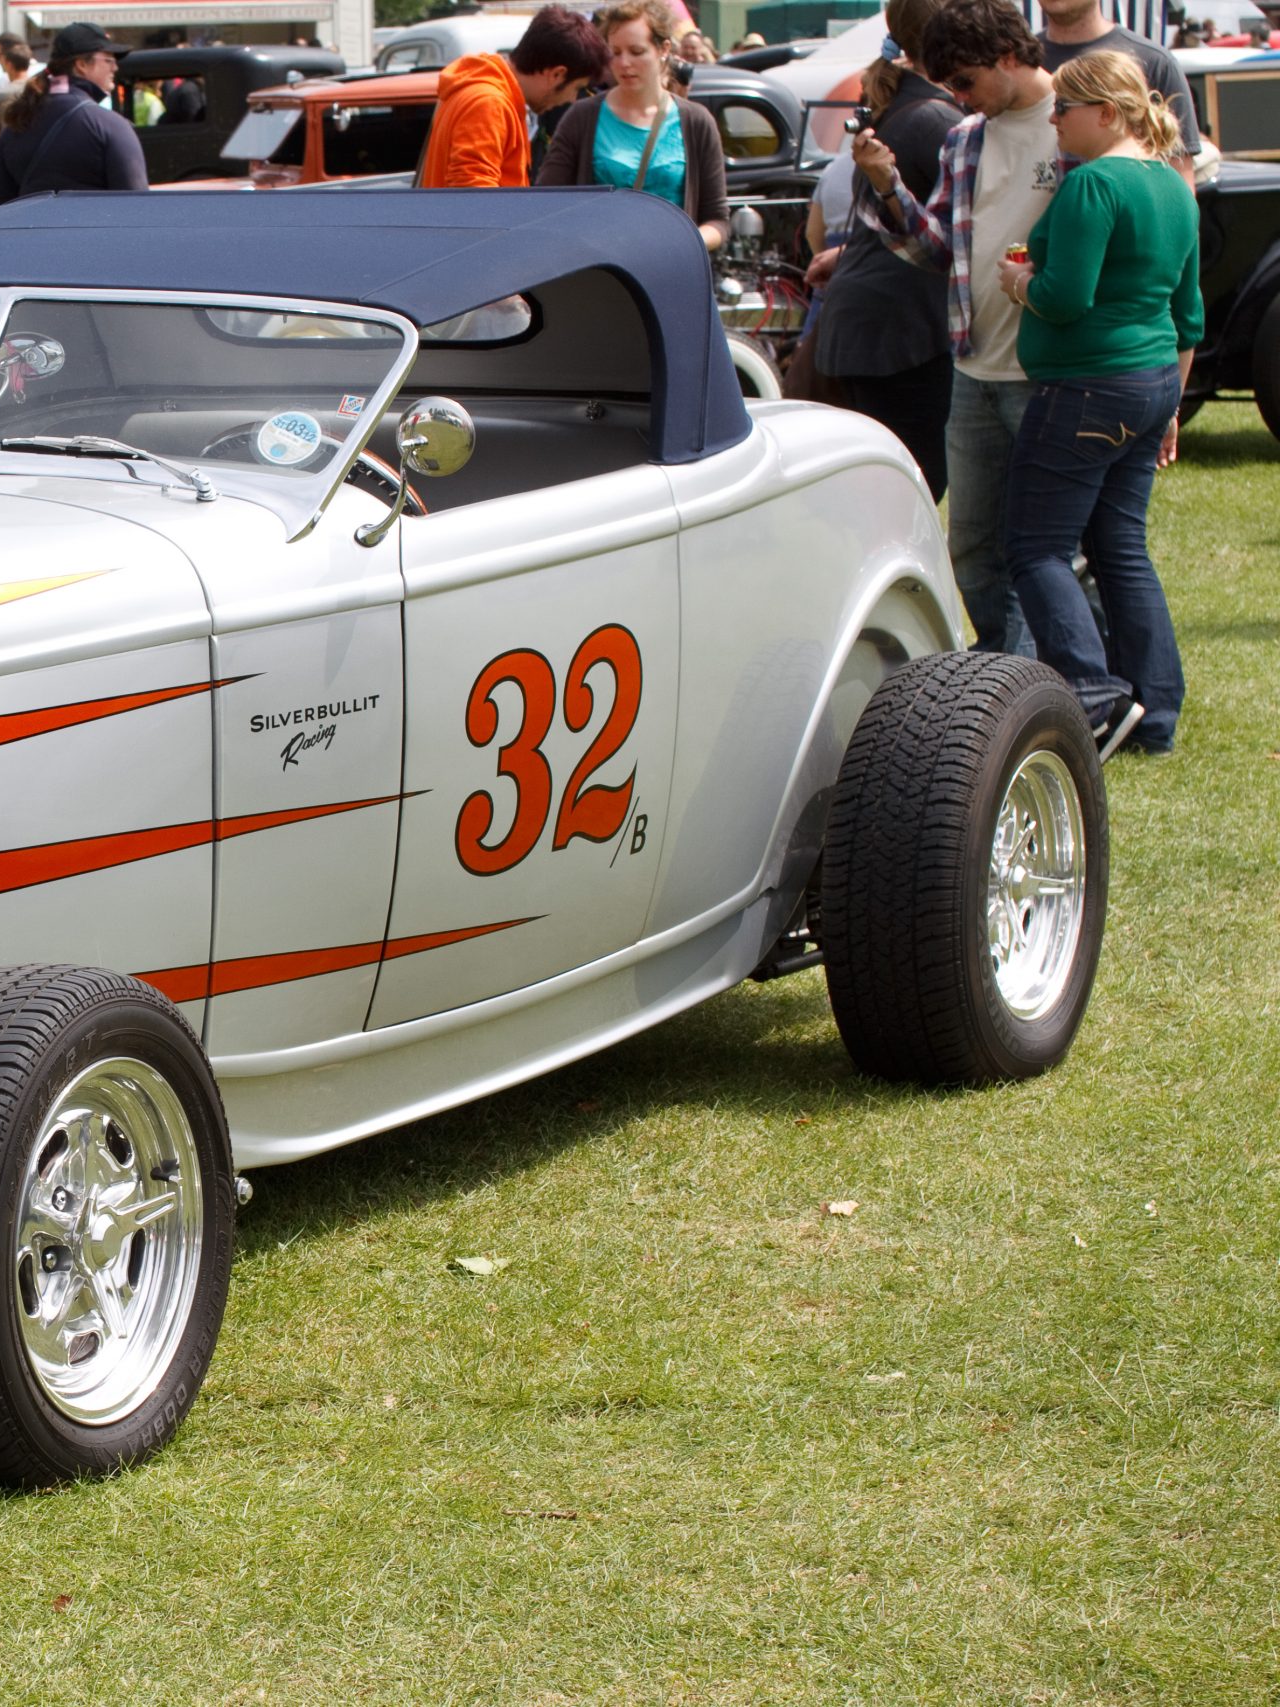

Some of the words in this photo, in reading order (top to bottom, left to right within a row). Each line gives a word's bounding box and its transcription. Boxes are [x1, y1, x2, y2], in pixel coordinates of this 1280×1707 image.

[250, 694, 380, 733] SILVERBULLIT
[280, 724, 337, 772] Racing
[455, 623, 643, 877] 32
